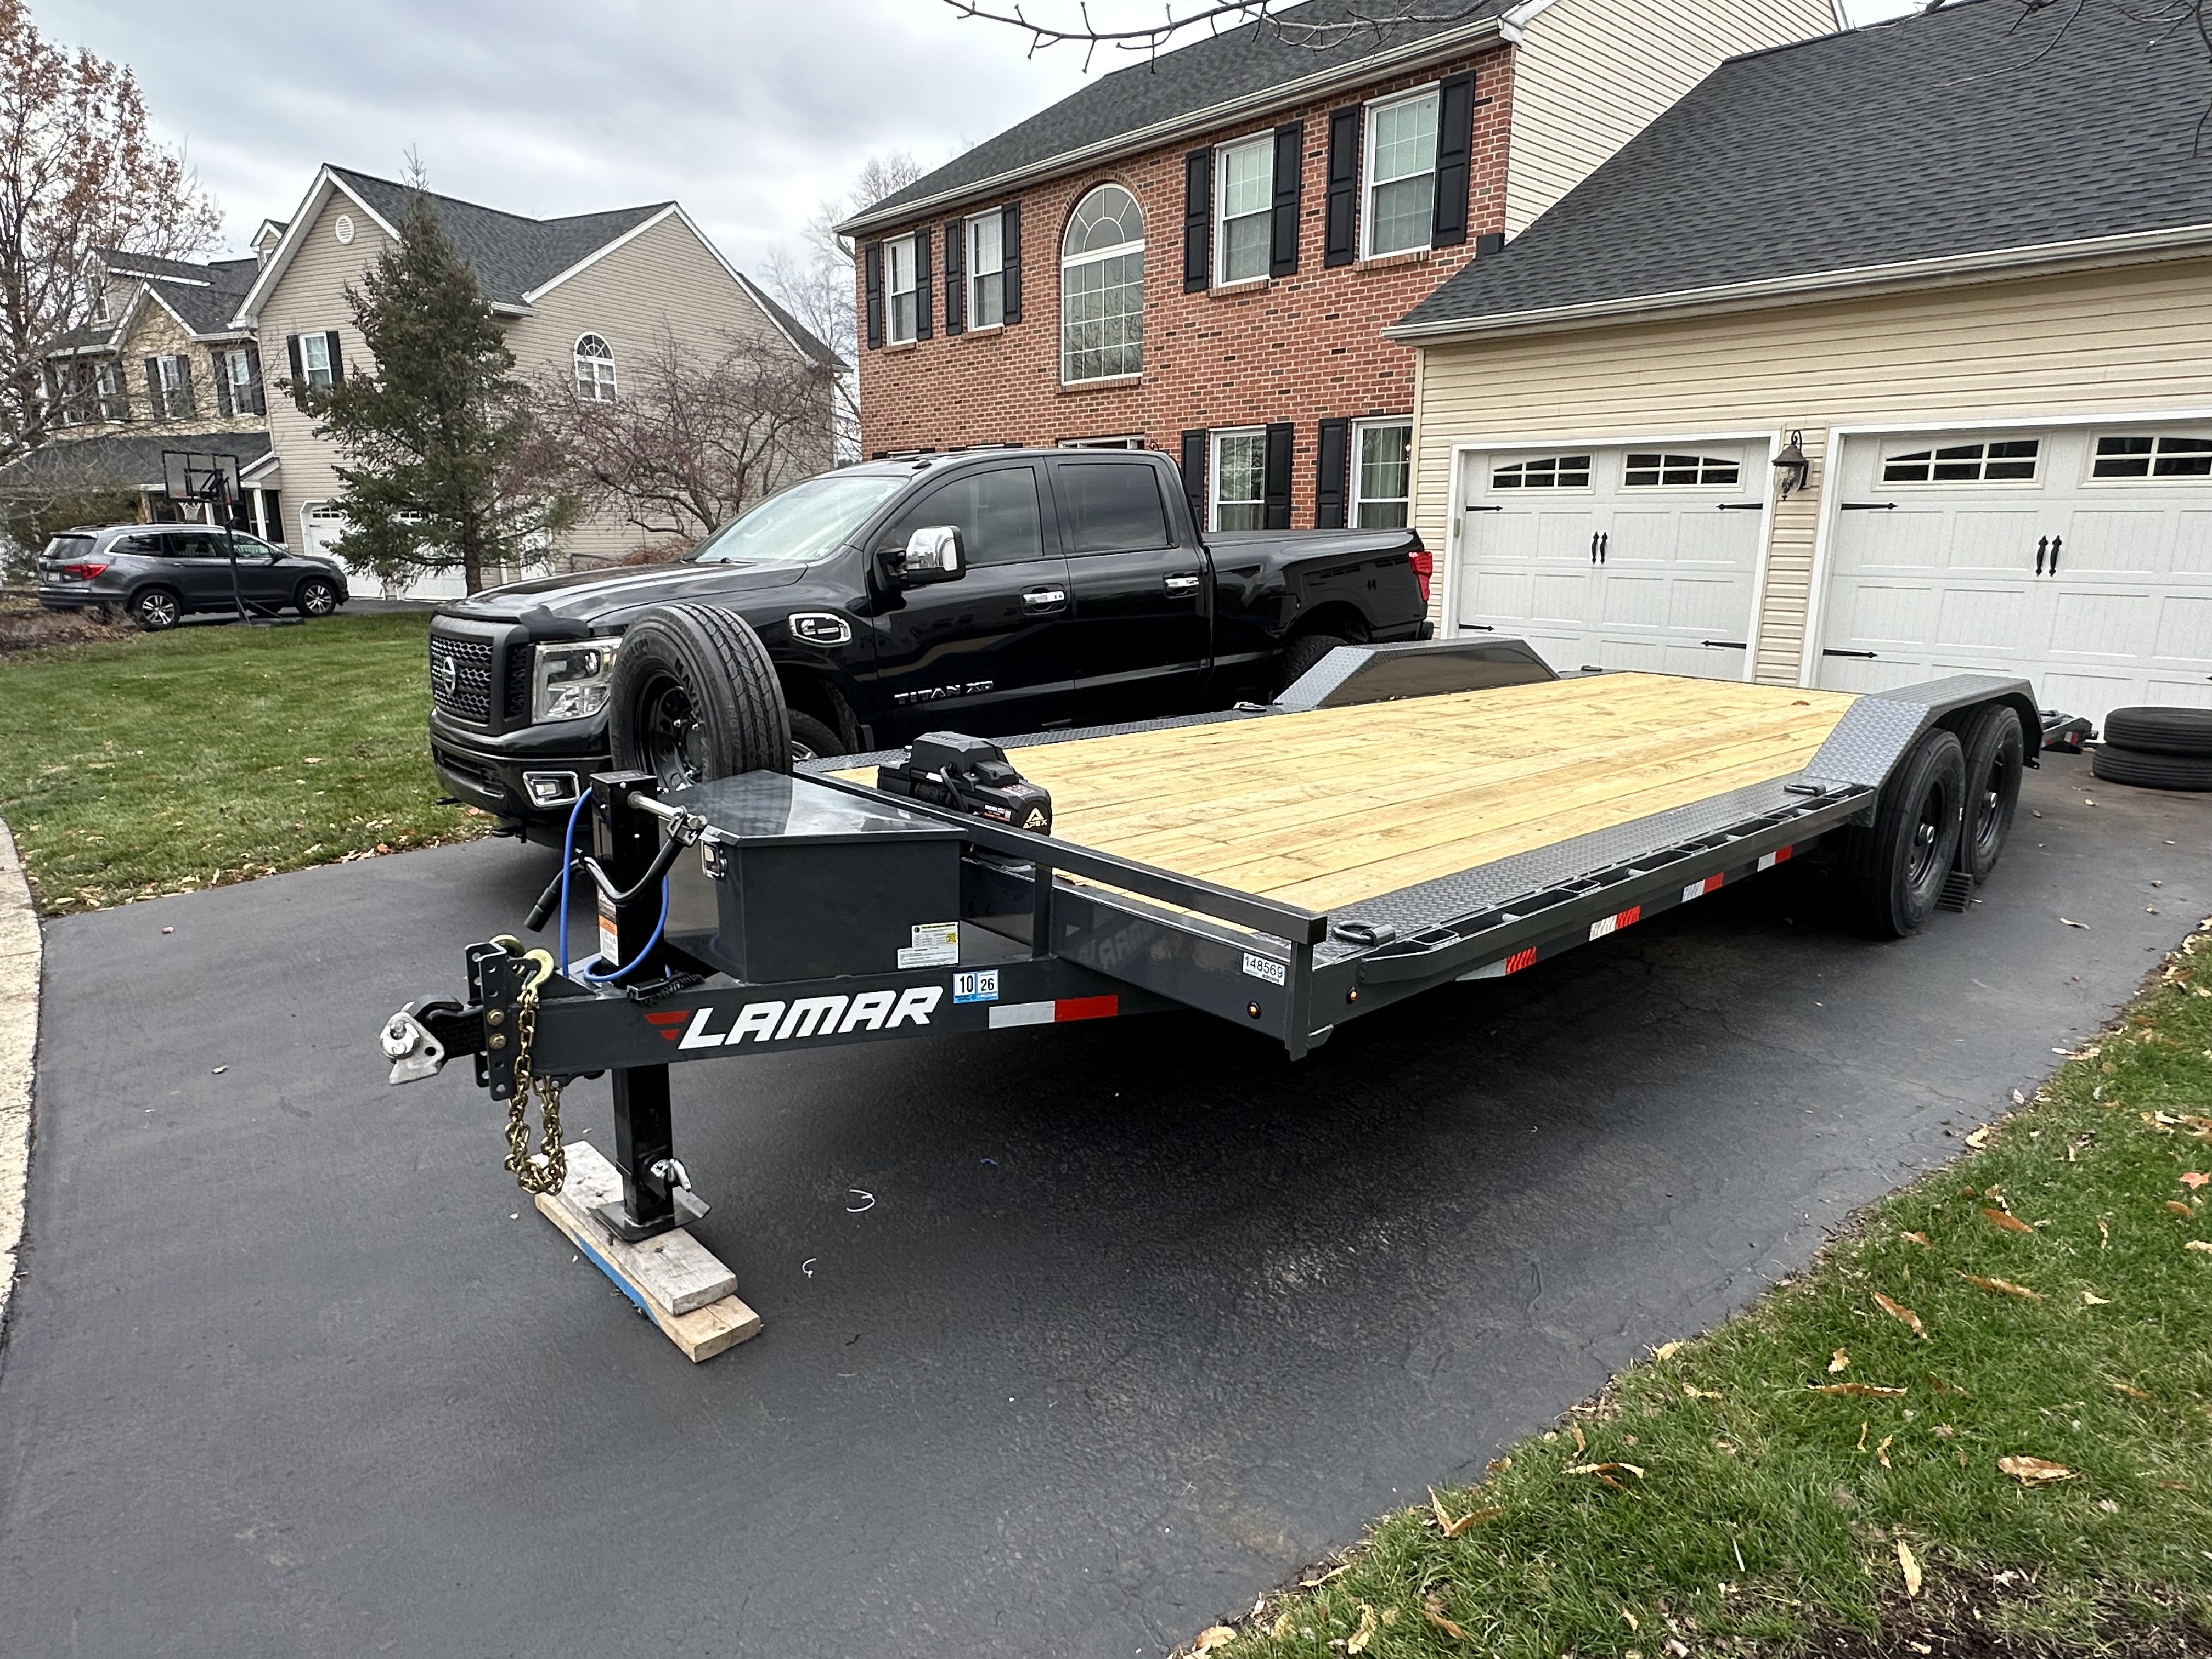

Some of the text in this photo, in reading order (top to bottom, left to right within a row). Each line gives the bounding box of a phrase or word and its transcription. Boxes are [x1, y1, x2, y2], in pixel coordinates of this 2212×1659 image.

[894, 680, 994, 704] TITAN XD
[1023, 819, 1048, 830] APEX
[1245, 956, 1283, 978] 148569
[959, 975, 973, 994] 10
[980, 978, 995, 992] 26
[678, 986, 944, 1051] LAMAR
